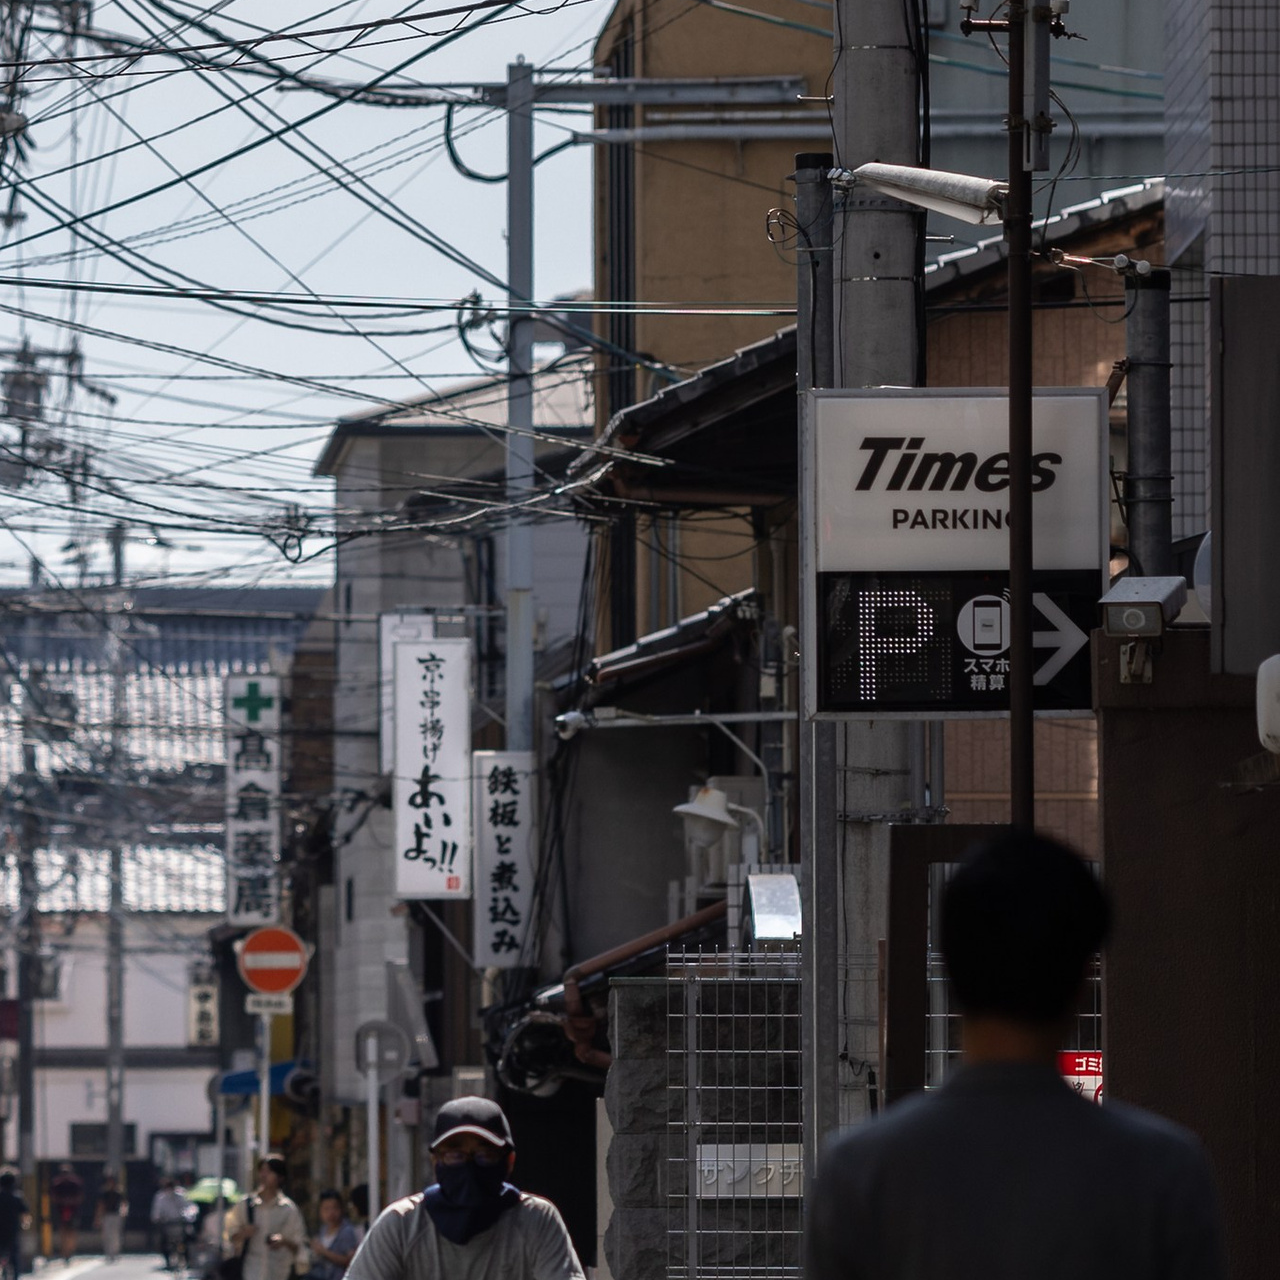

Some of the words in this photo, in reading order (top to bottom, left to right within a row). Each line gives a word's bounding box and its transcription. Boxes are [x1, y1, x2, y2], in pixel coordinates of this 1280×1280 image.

[855, 437, 1063, 492] Times
[892, 508, 1010, 530] PARKIN
[963, 658, 1010, 673] スマホ
[970, 674, 1005, 691] 精算
[416, 652, 446, 763] 京串揚げ
[487, 765, 521, 955] 鉄板と煮込み
[1075, 1056, 1102, 1073] ゴミ
